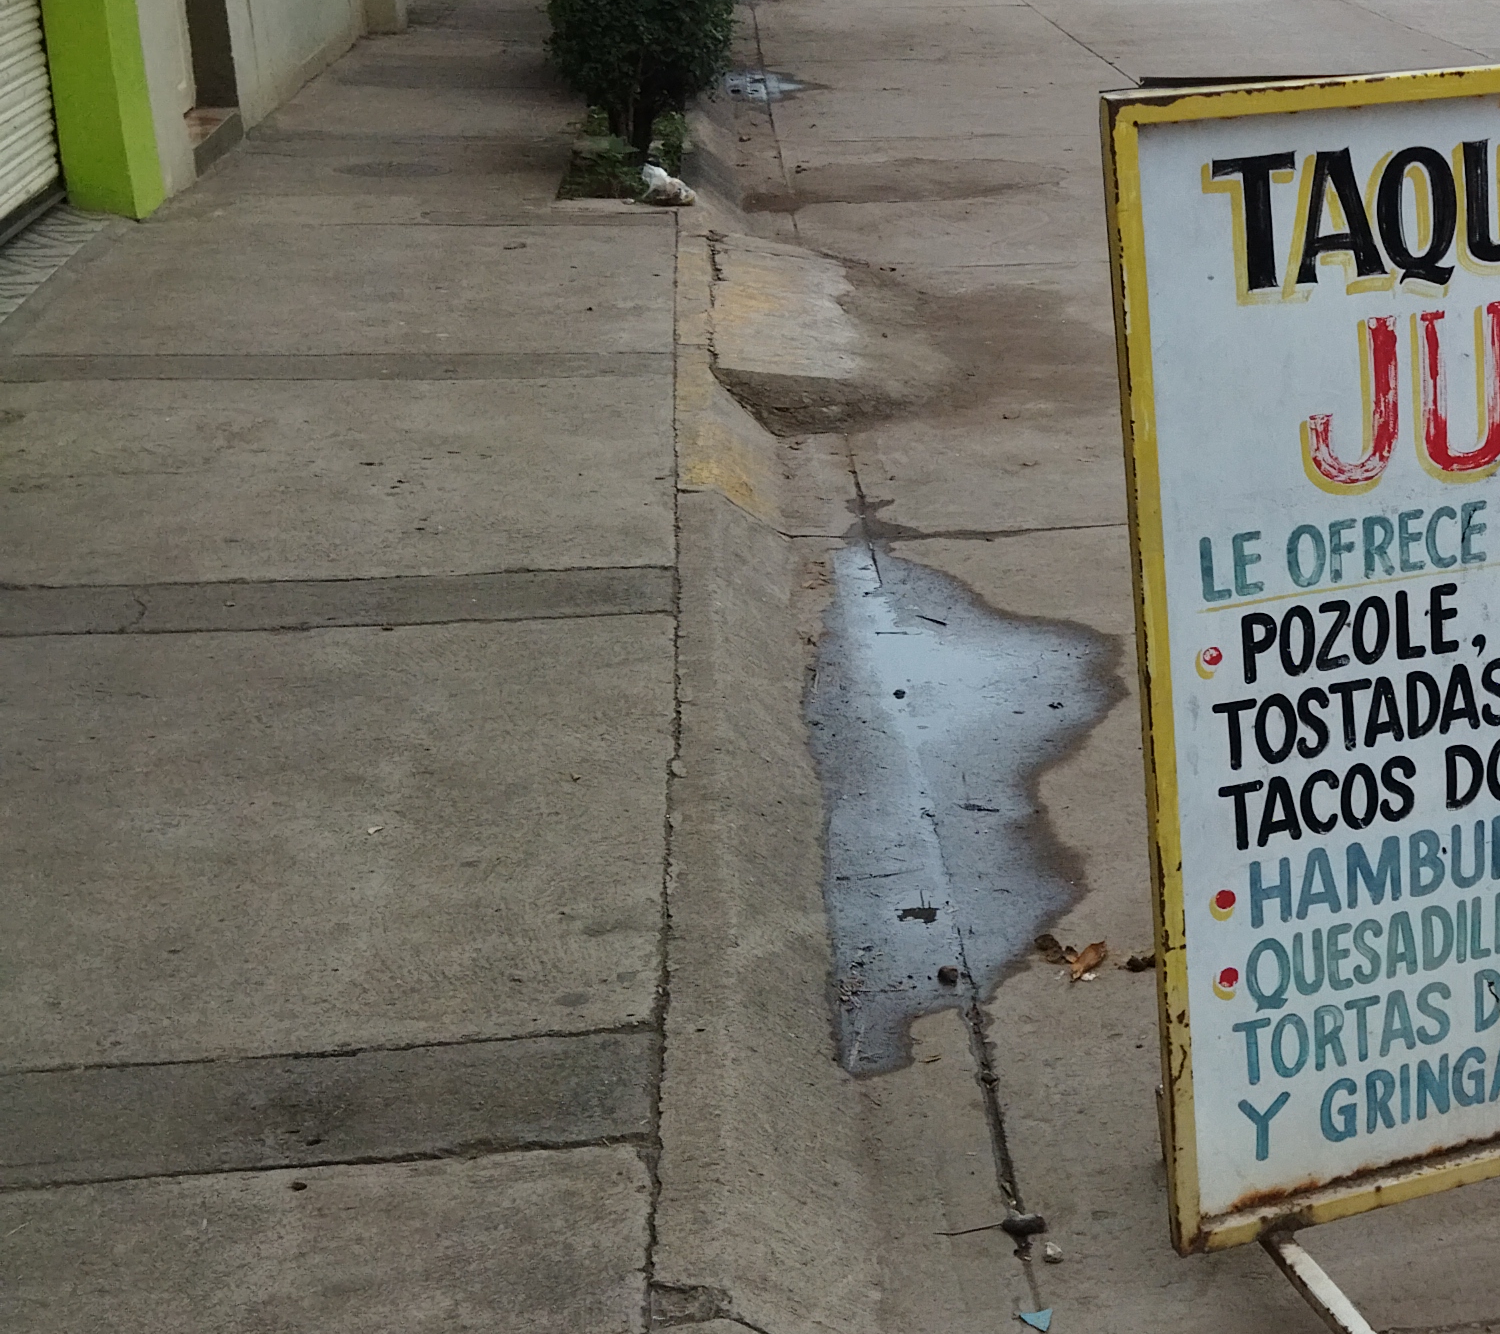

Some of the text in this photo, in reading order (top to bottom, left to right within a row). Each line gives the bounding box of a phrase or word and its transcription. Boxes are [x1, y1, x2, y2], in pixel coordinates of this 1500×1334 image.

[1199, 530, 1264, 603] LE
[1287, 500, 1488, 588] OFRECE
[1241, 583, 1486, 684] POZOLE,
[1218, 755, 1415, 851] TACOS
[1232, 982, 1451, 1087] TORTAS
[1238, 1092, 1290, 1162] Y
